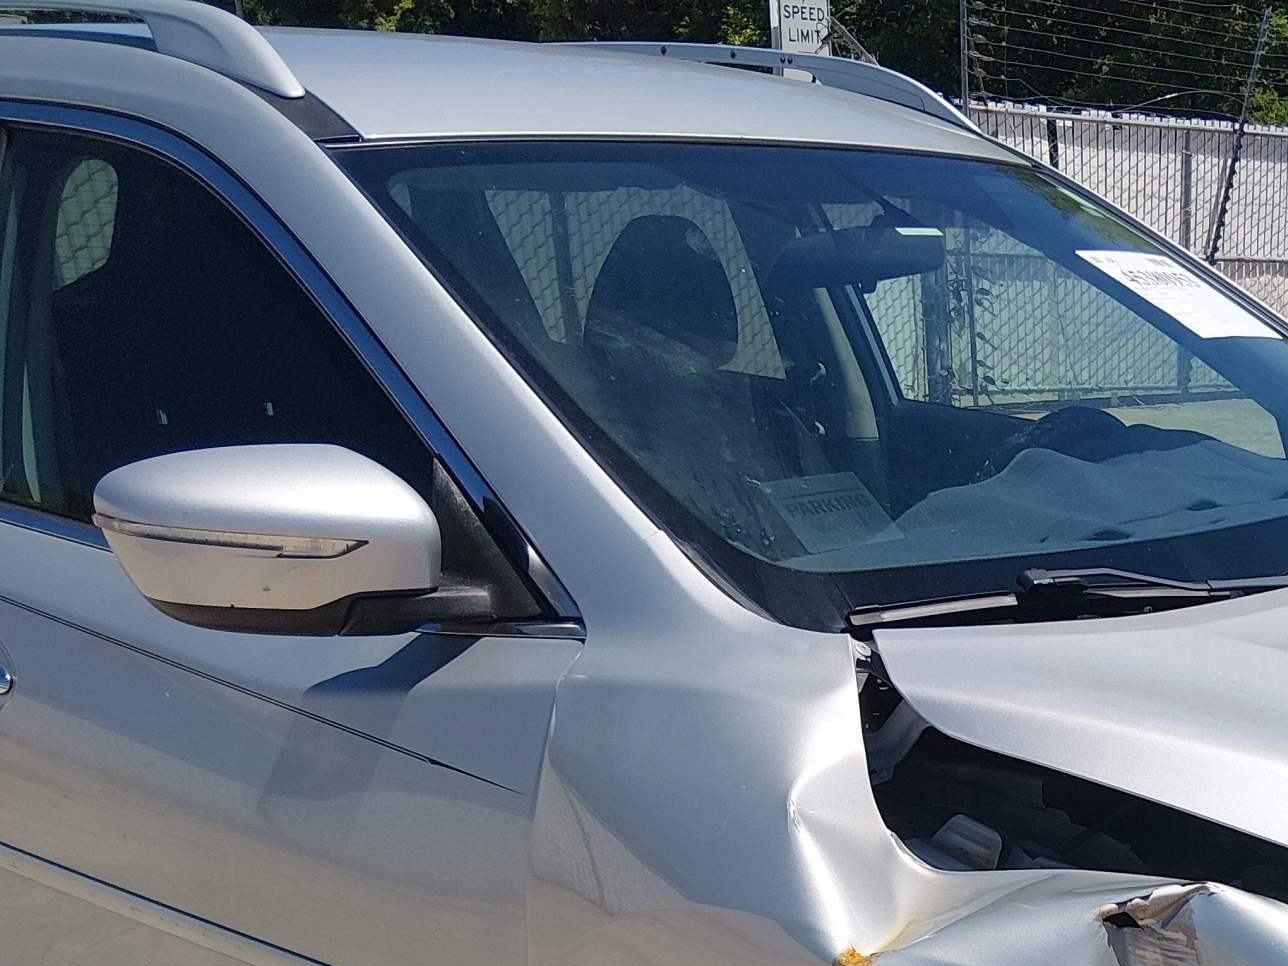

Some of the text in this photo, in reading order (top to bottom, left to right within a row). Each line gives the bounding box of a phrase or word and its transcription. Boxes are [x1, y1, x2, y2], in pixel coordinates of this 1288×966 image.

[783, 4, 825, 22] SPEED
[788, 27, 822, 44] LIMIT
[783, 493, 872, 519] PARKING
